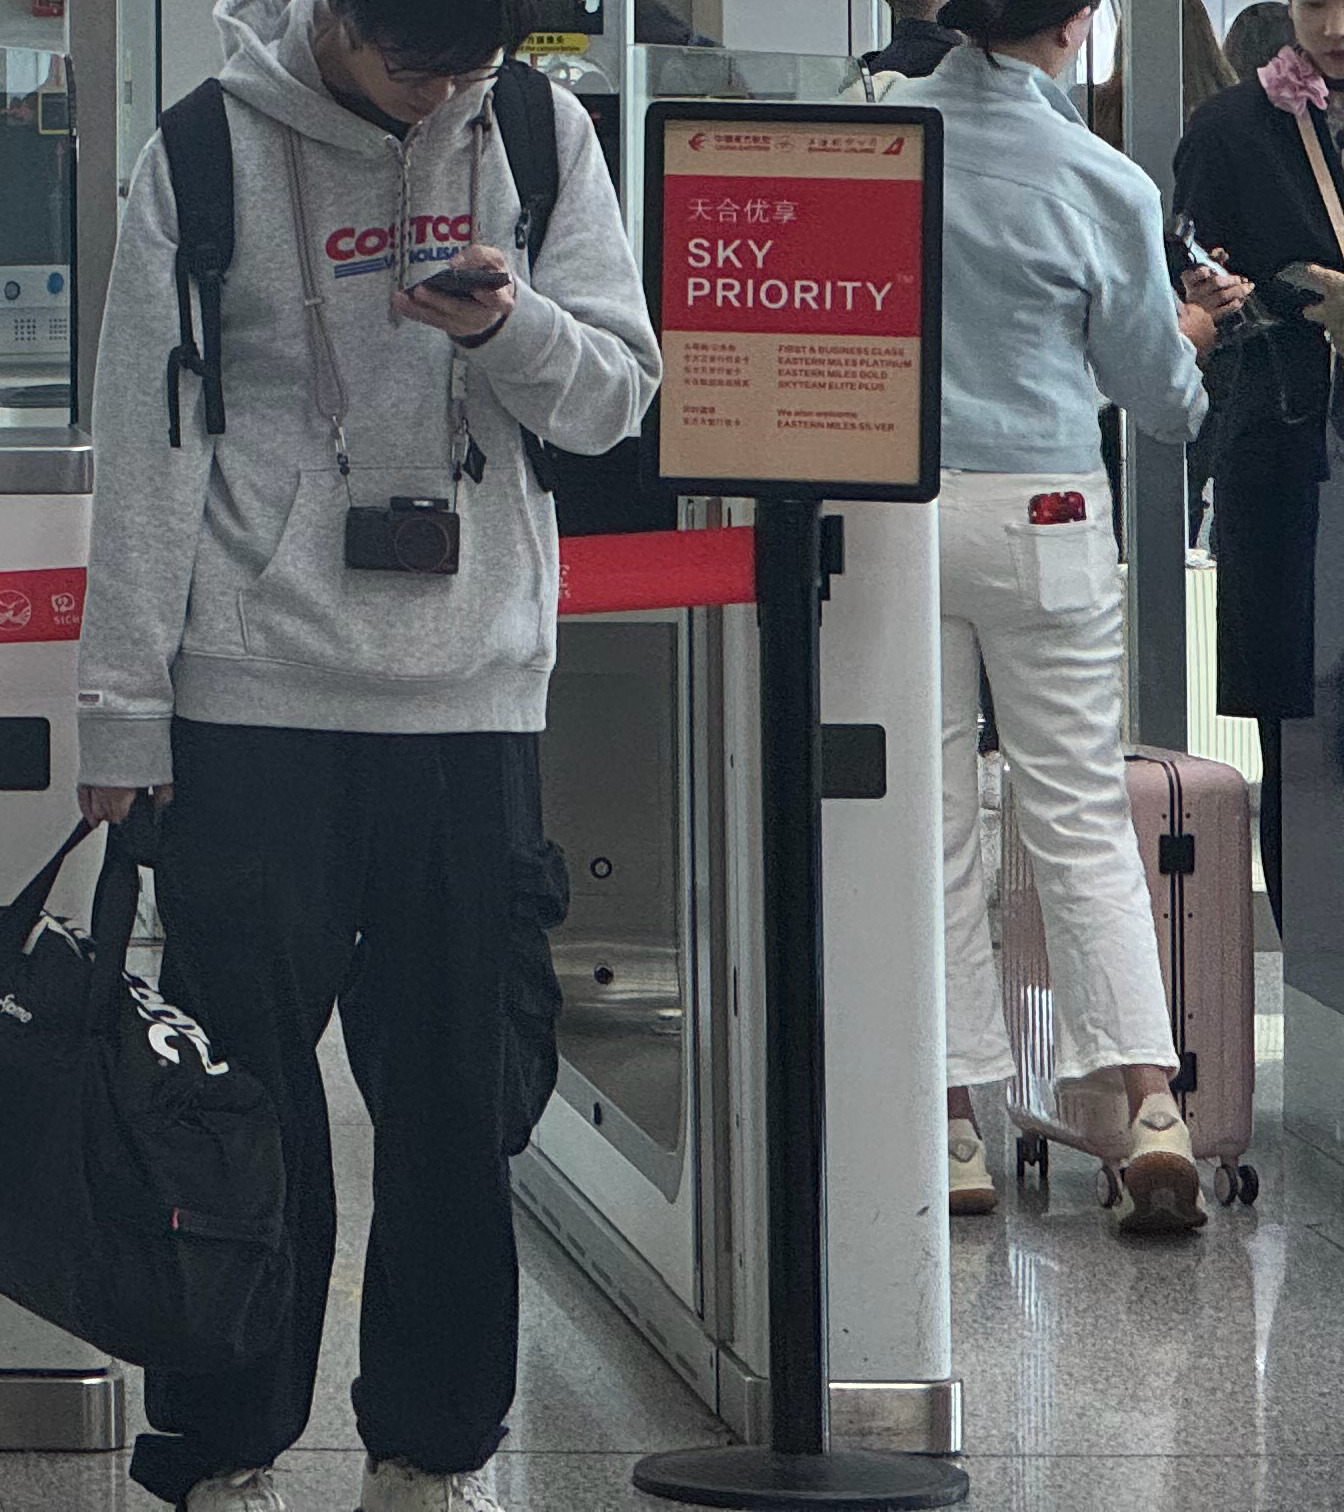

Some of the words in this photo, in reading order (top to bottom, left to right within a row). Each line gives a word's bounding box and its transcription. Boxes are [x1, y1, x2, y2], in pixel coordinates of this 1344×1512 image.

[688, 199, 798, 224] 天合优享
[688, 238, 773, 268] SKY
[687, 278, 893, 311] PRIORITY
[778, 357, 826, 366] EASTERN
